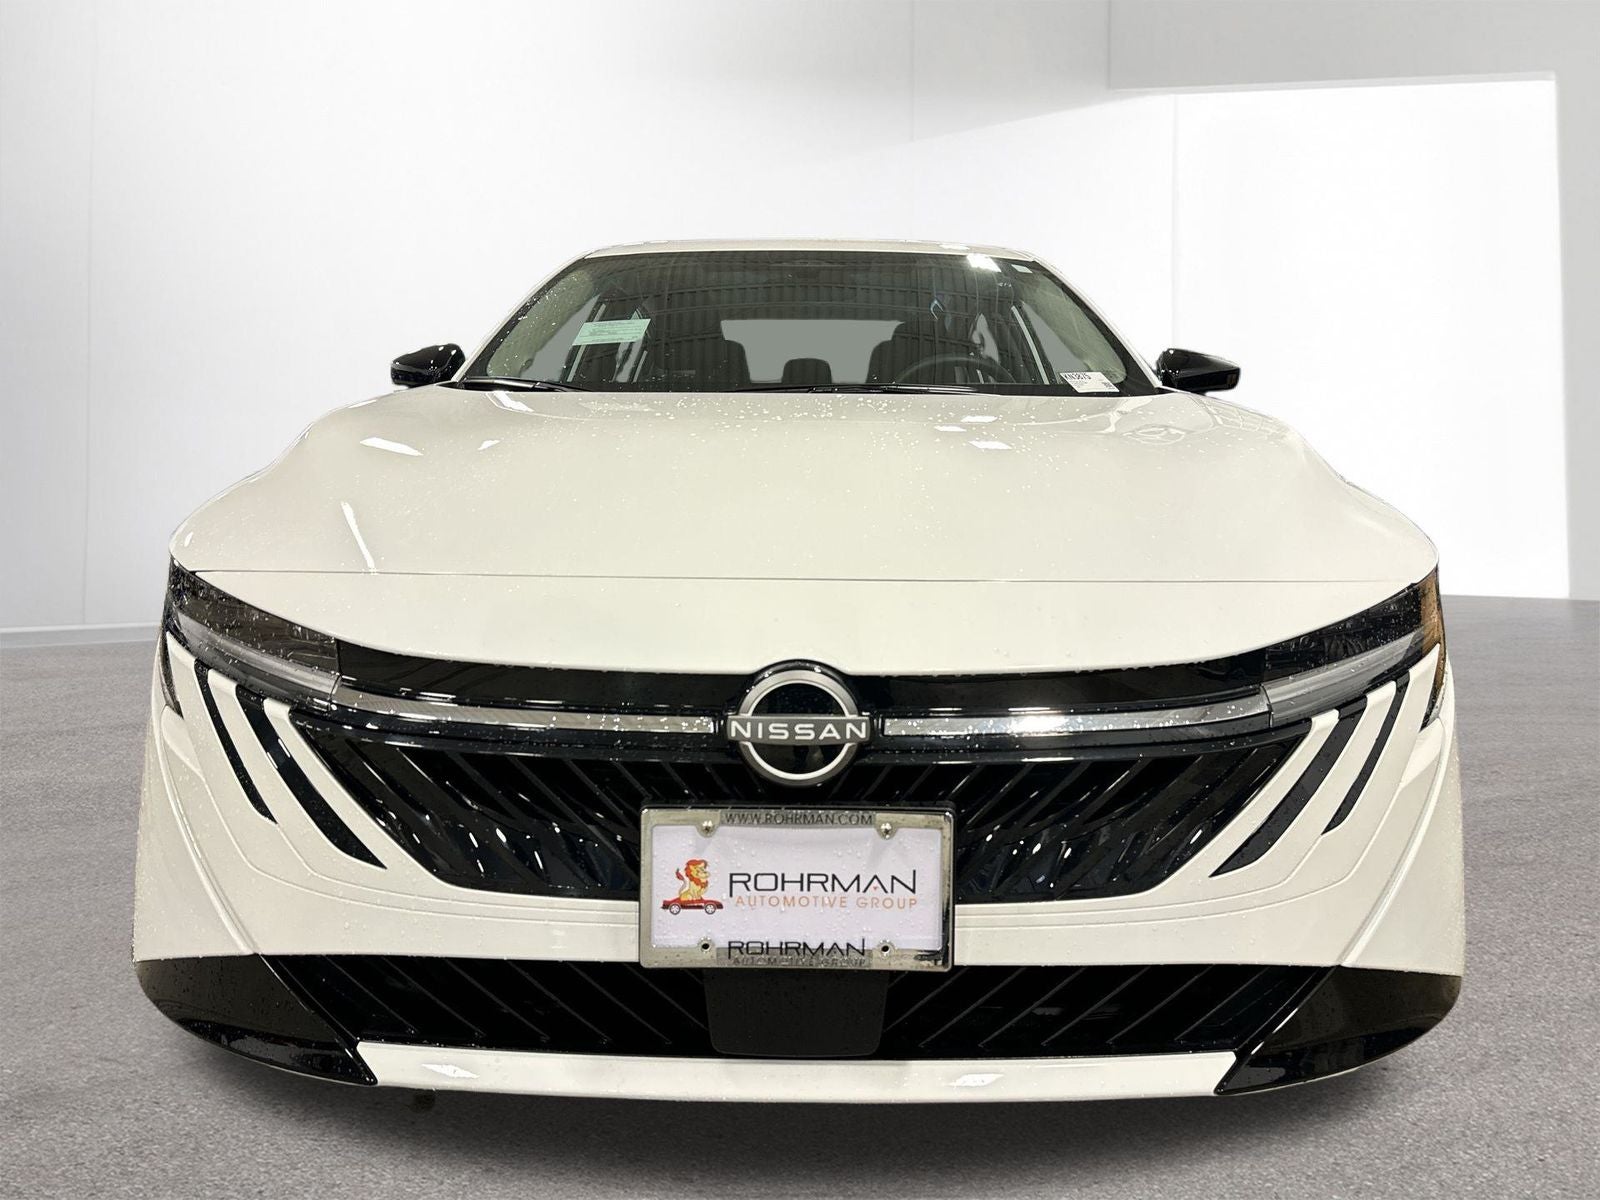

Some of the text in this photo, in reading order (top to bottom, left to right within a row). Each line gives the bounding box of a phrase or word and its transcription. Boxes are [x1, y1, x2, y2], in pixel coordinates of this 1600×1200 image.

[730, 720, 867, 741] NISSAN
[725, 812, 873, 825] WWW.ROHRMAN.COM
[728, 869, 917, 898] ROHRMAN
[735, 895, 918, 910] AUTOMOTIVE GROUP
[728, 938, 866, 960] ROHRMAN
